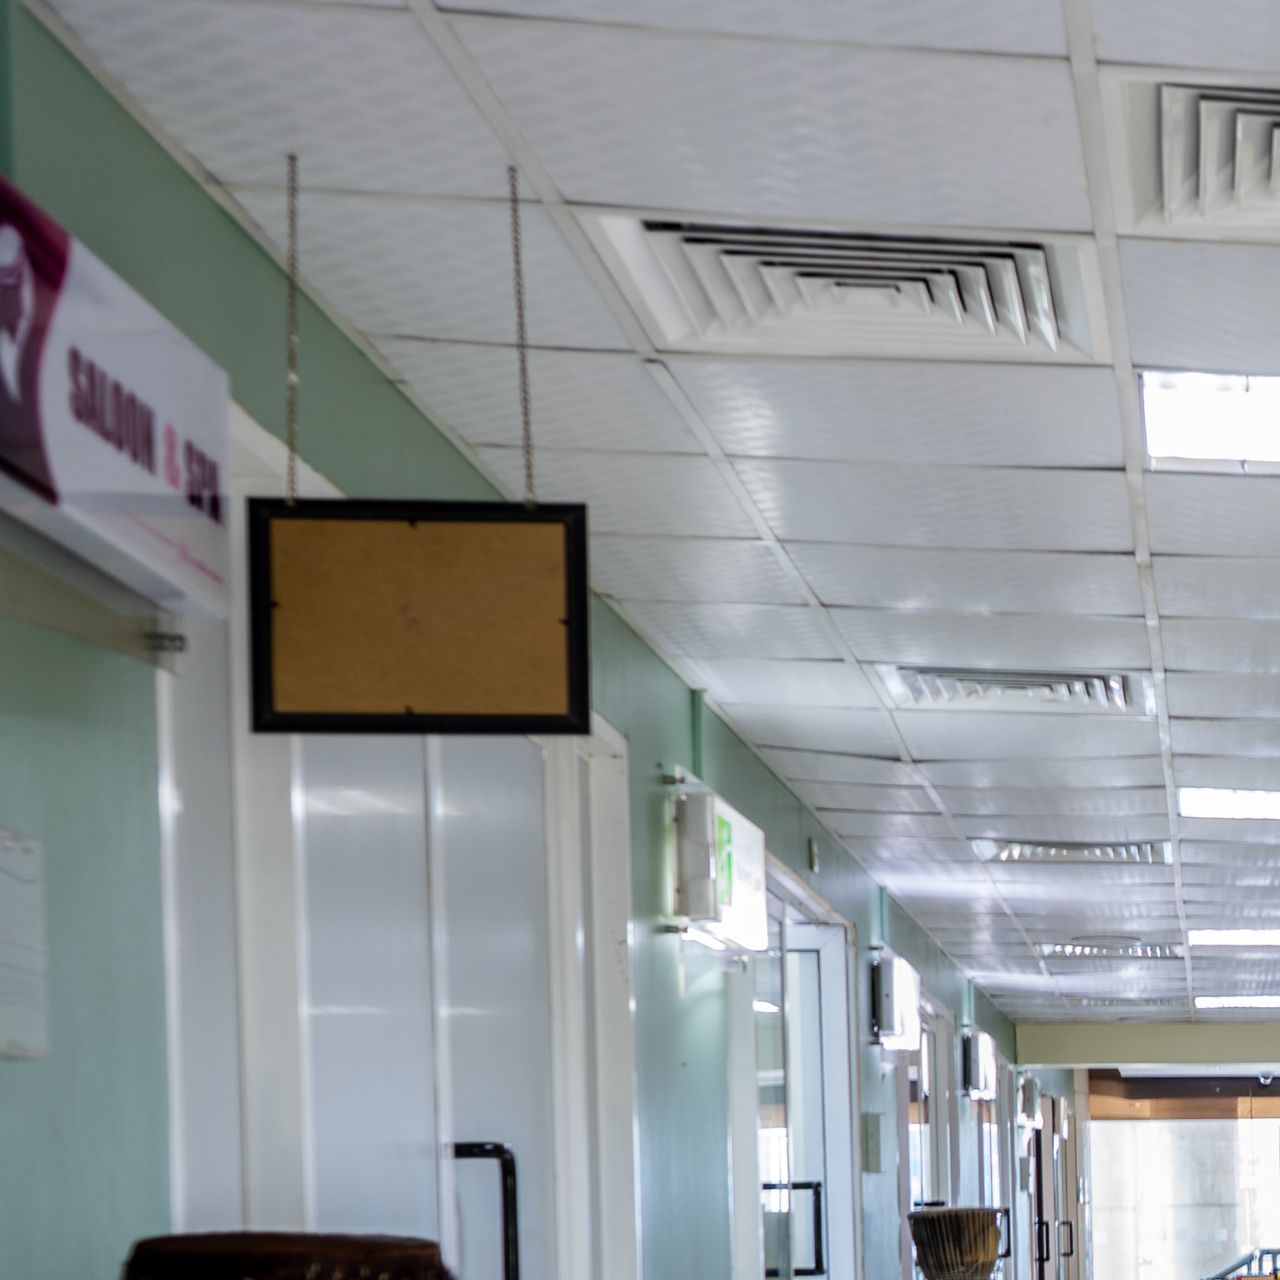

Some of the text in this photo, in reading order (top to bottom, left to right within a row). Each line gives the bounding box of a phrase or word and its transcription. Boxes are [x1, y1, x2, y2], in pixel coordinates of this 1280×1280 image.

[68, 345, 222, 526] SALOON & SPA
